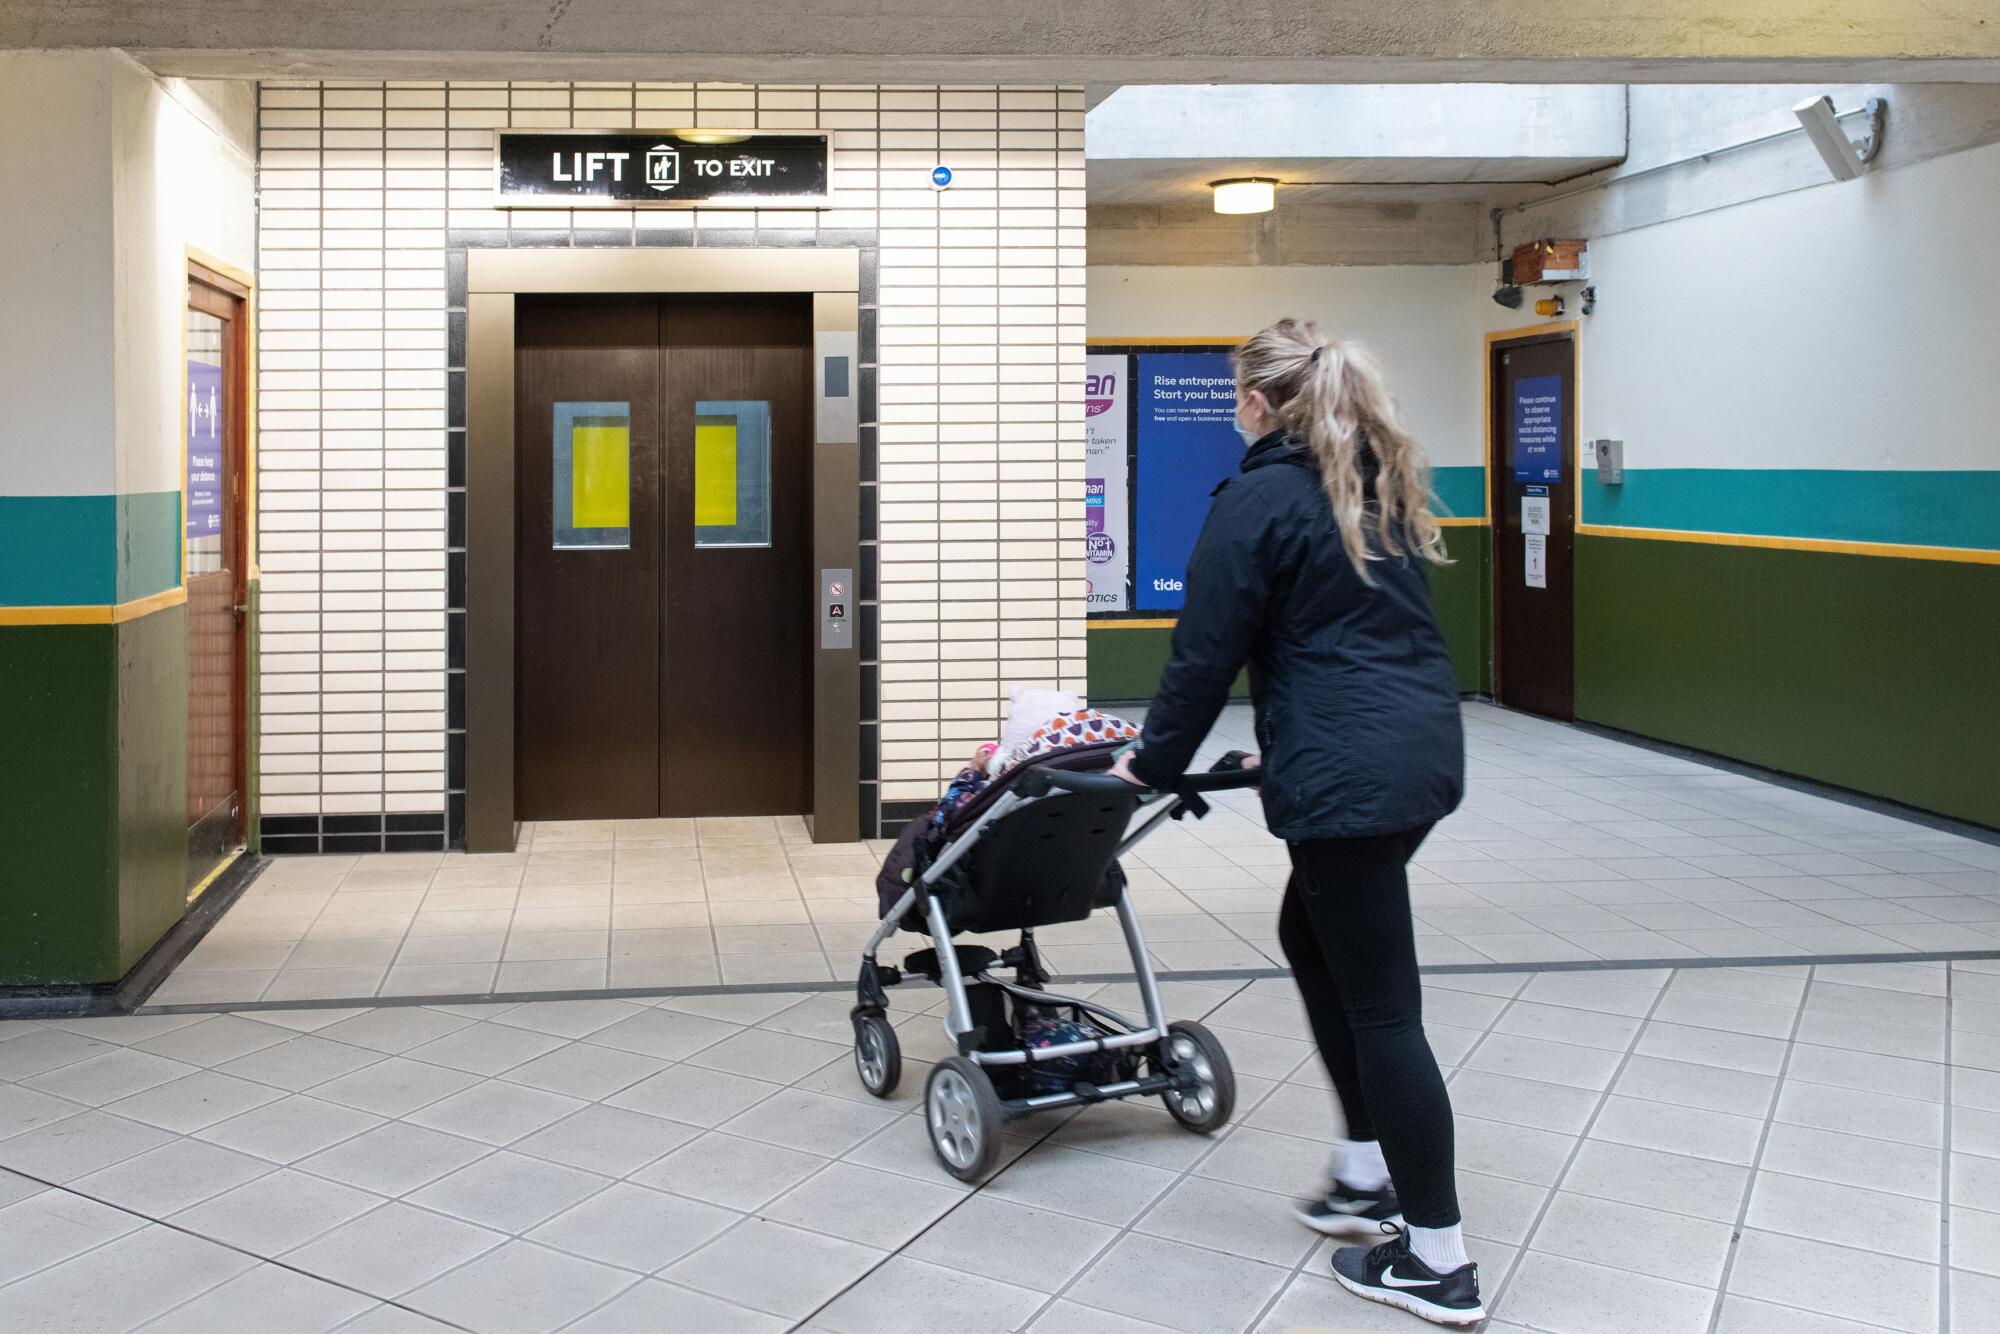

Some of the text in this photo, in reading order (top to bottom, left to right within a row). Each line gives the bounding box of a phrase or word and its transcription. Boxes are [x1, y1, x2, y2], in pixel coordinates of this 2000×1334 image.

[553, 152, 775, 182] LIFT TO EXIT
[1154, 376, 1177, 386] Rise
[1154, 389, 1182, 399] Start
[1184, 392, 1209, 402] your
[1533, 426, 1557, 434] distancing
[1154, 579, 1183, 591] tide
